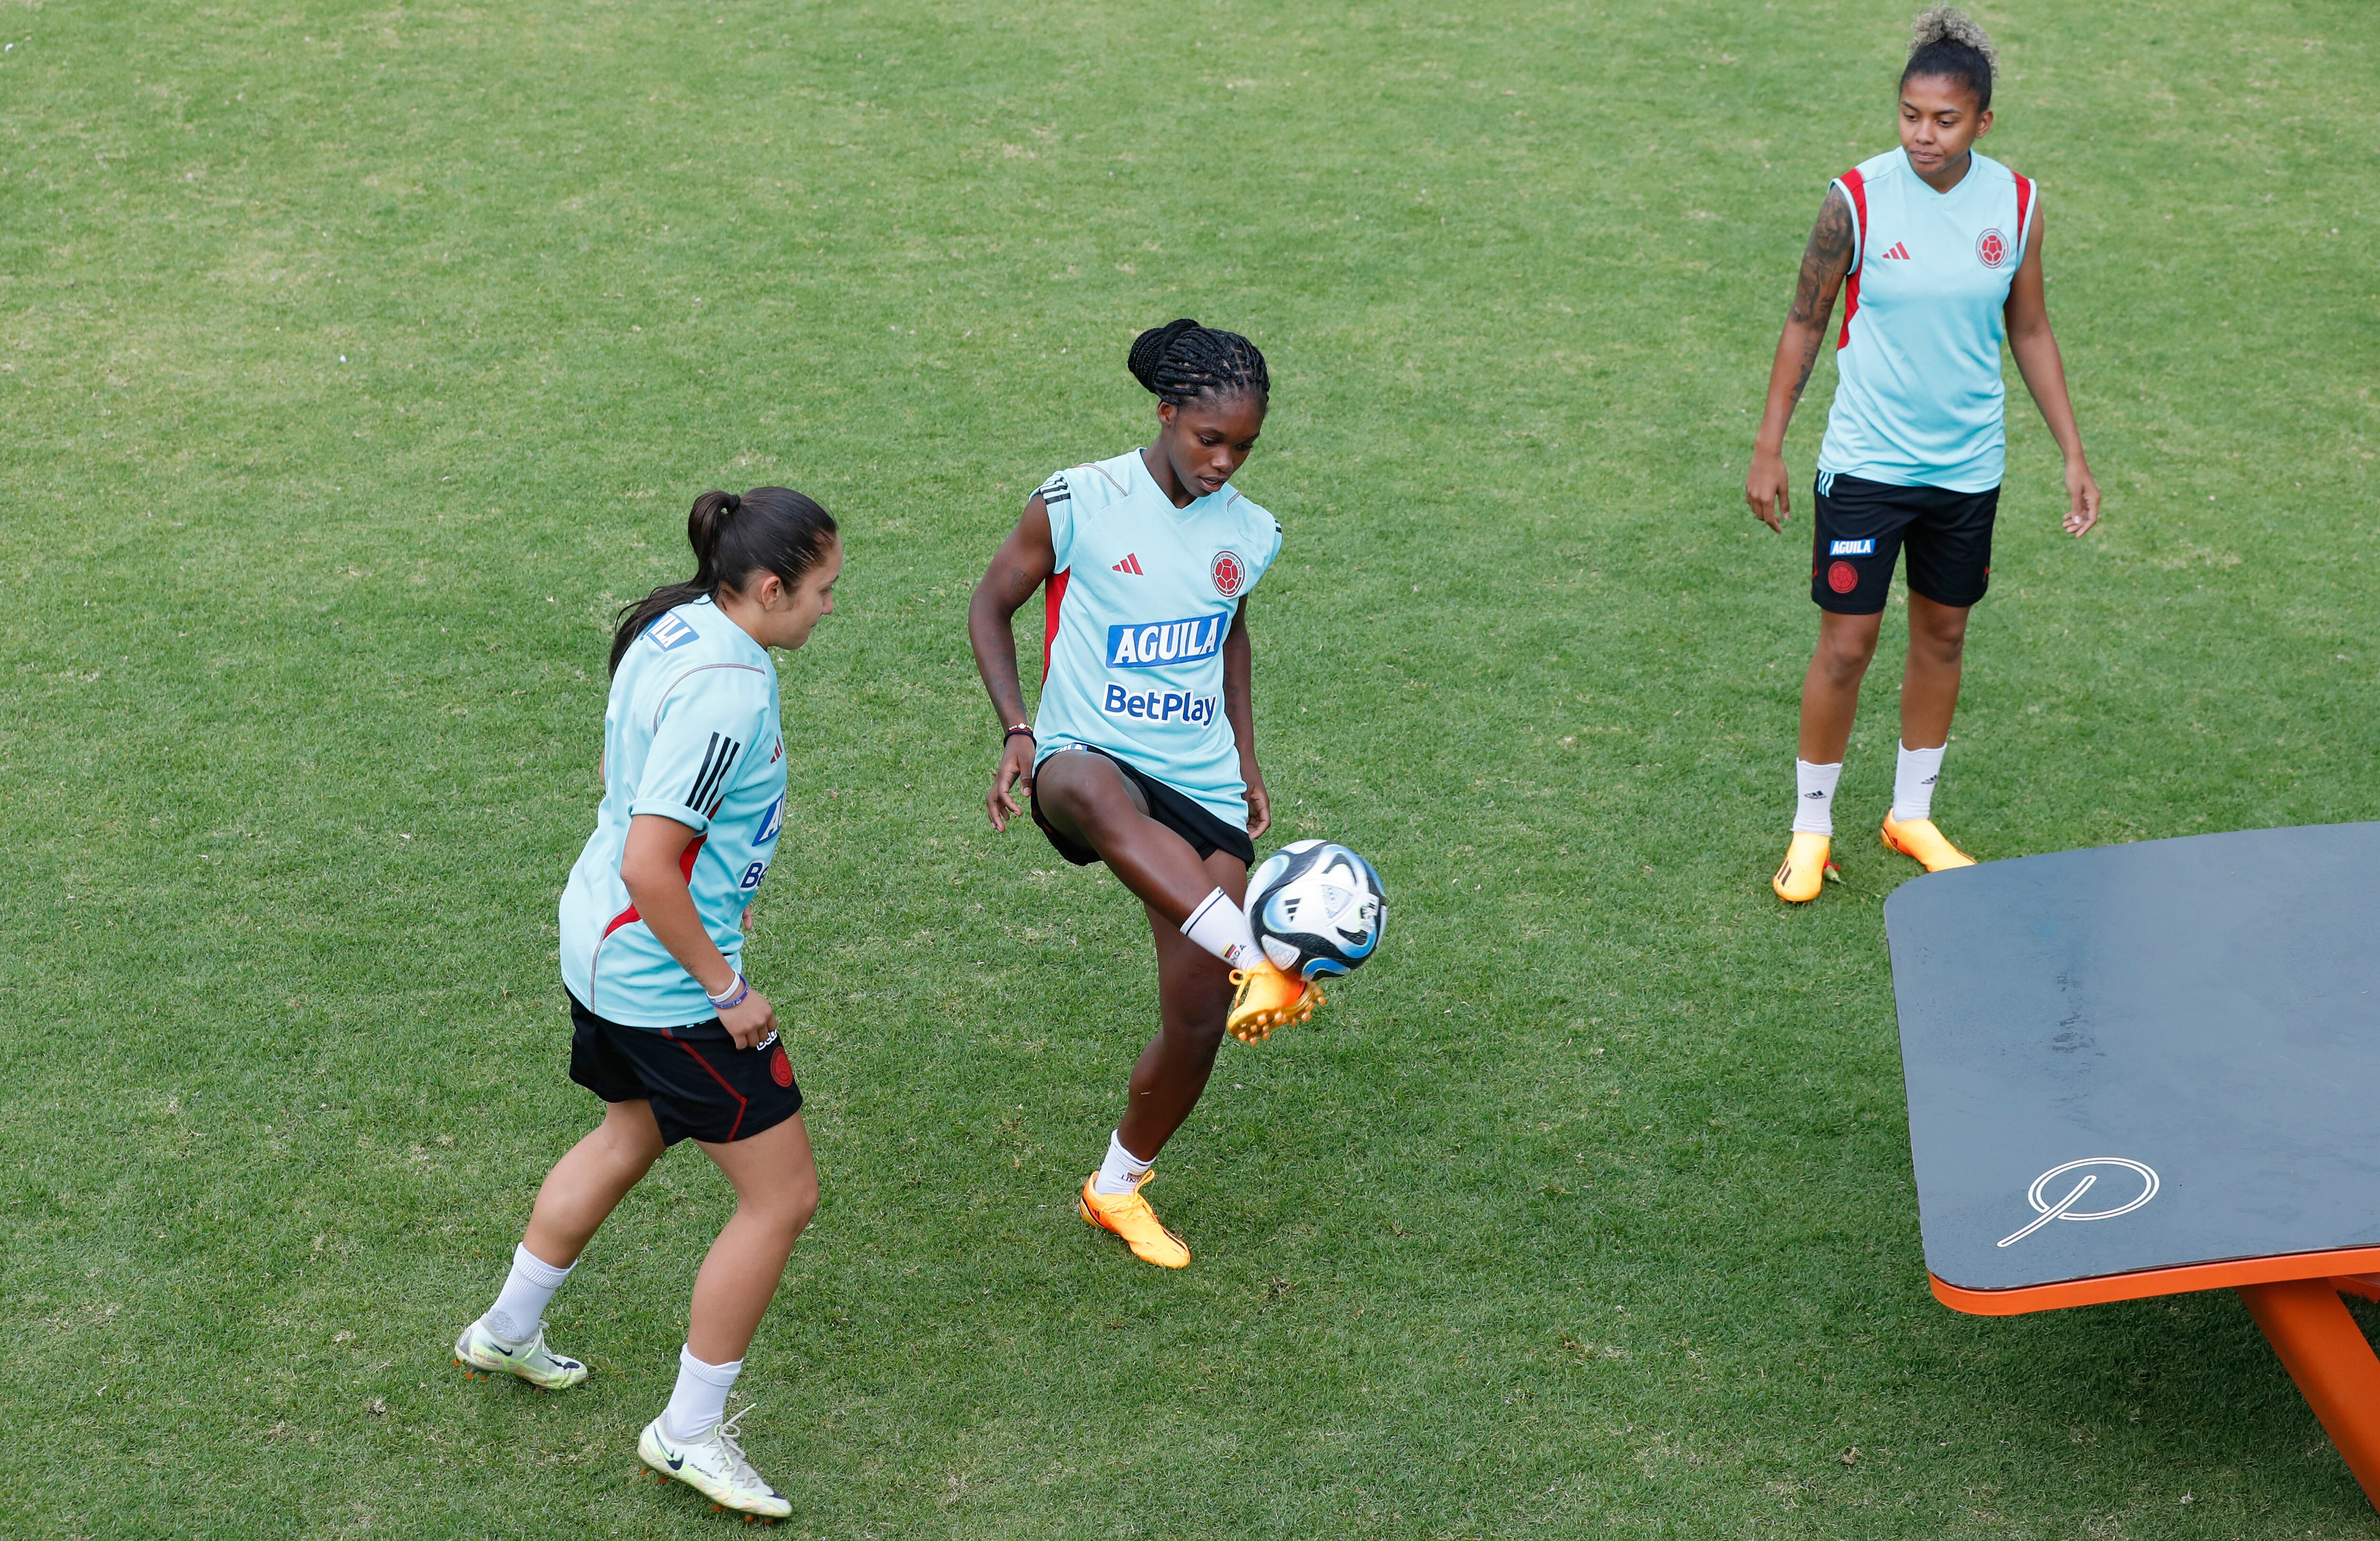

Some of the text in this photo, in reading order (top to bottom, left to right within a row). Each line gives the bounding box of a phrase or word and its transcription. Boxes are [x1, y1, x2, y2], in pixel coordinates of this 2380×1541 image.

[1831, 540, 1872, 555] AGUILA
[1111, 616, 1220, 664] AGUILA
[1104, 684, 1216, 726] BetPlay
